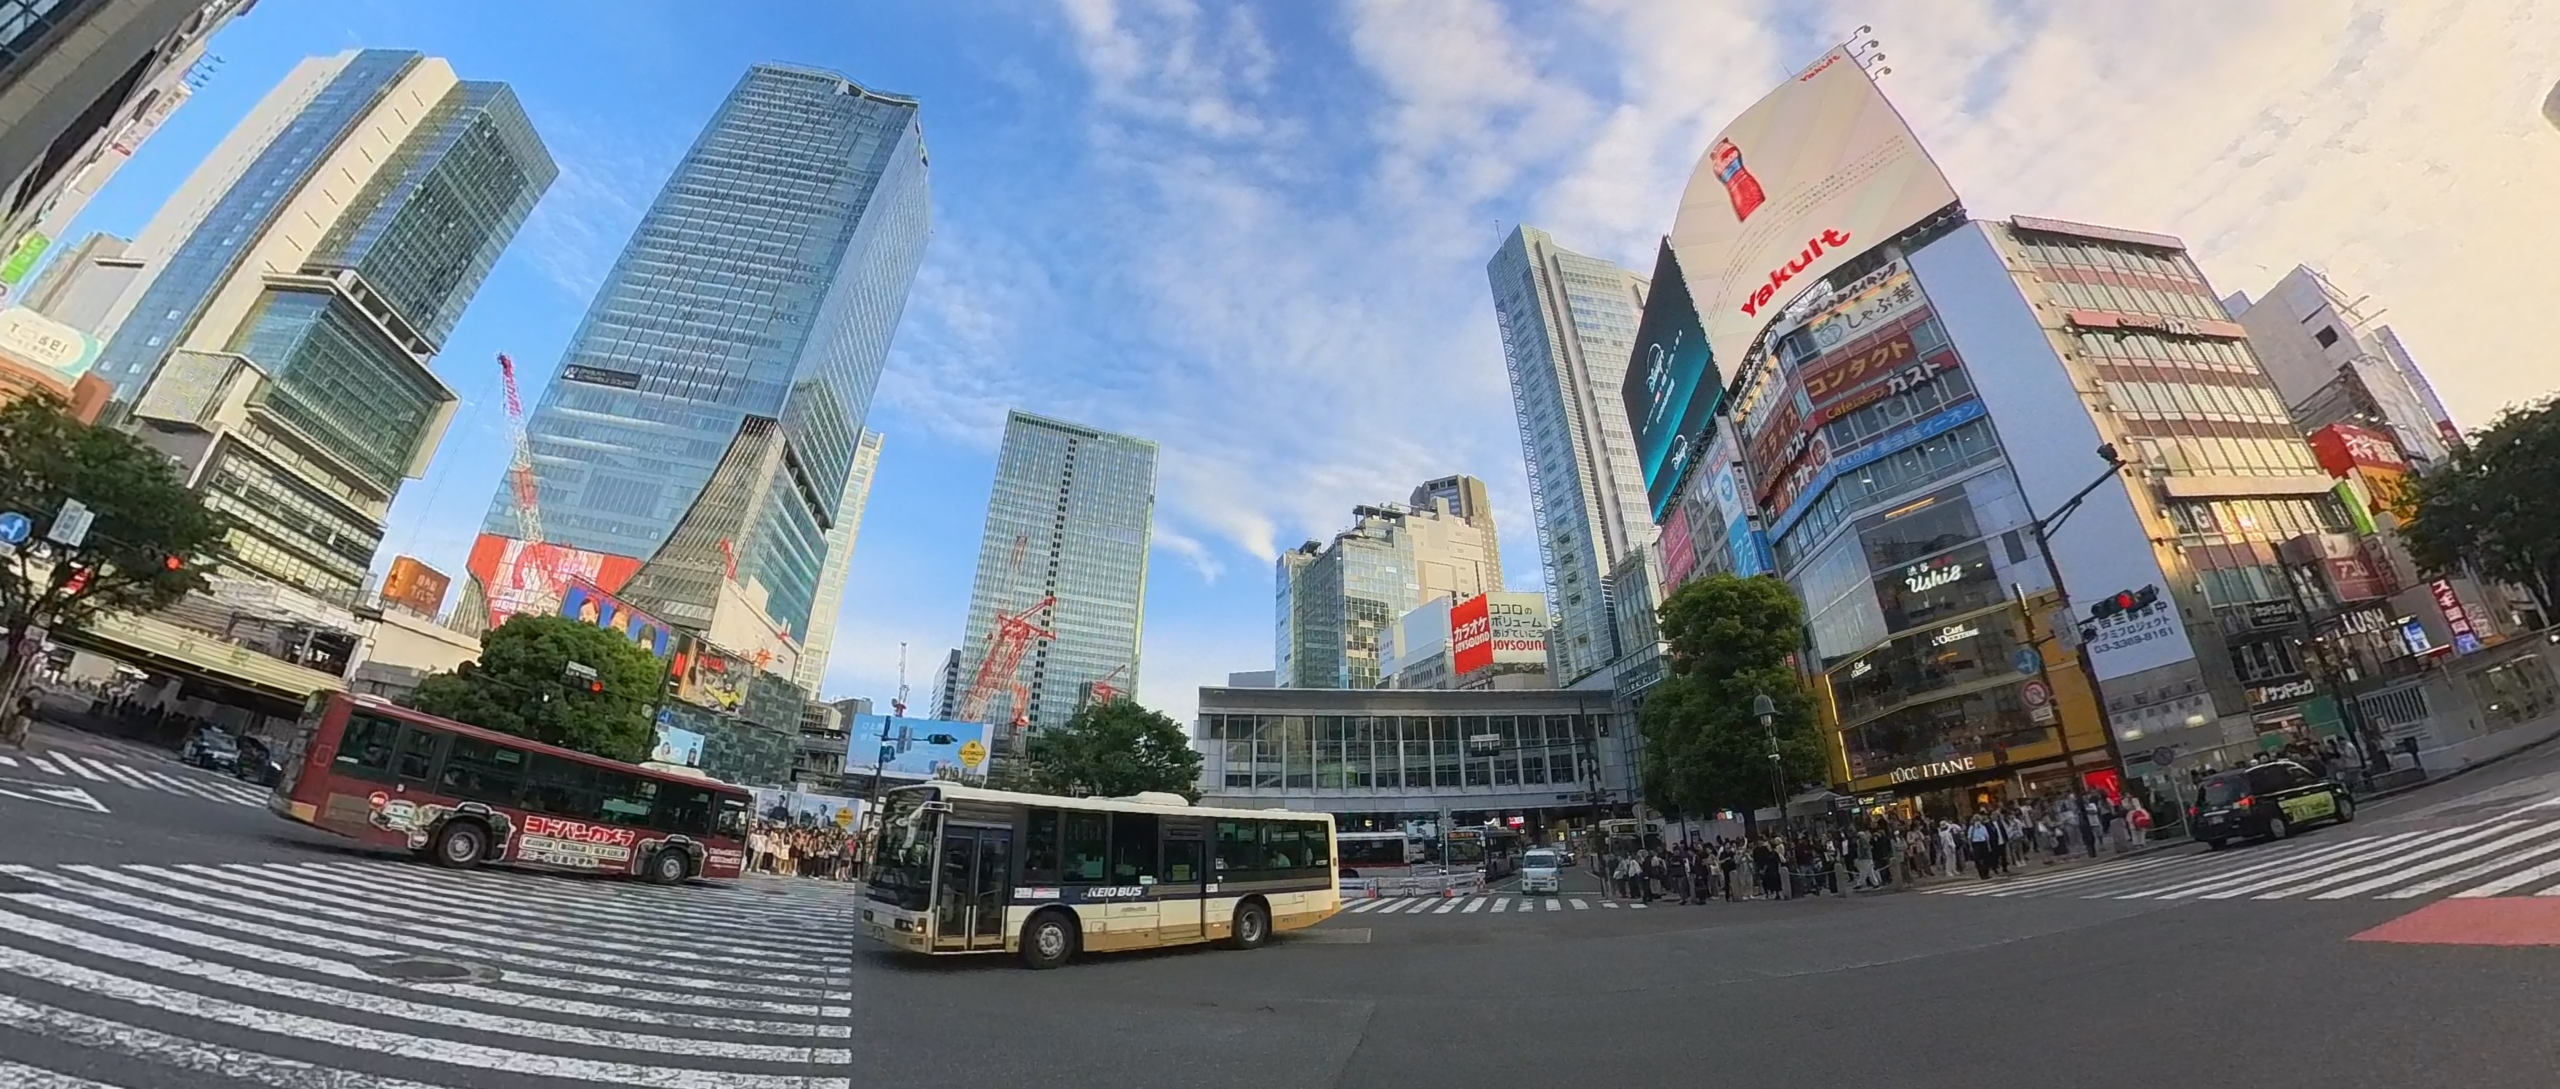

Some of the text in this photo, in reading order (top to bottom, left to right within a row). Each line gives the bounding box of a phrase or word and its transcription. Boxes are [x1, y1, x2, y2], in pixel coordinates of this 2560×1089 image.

[1799, 54, 1841, 82] Yakult
[1740, 228, 1851, 318] Yakult
[1844, 281, 1915, 329] しゃぶ葉
[1806, 340, 1909, 397] コンタクト
[1886, 360, 1940, 396] ガスト
[2335, 559, 2370, 580] アコム
[1489, 603, 1533, 615] ココロの
[2341, 608, 2390, 635] LUSH
[1454, 616, 1487, 643] カラオケ
[1455, 631, 1490, 654] JOYSOUND
[1492, 628, 1546, 638] あげていこう
[2267, 679, 2315, 701] サンドラッグ
[1087, 886, 1143, 898] KEIO BUS
